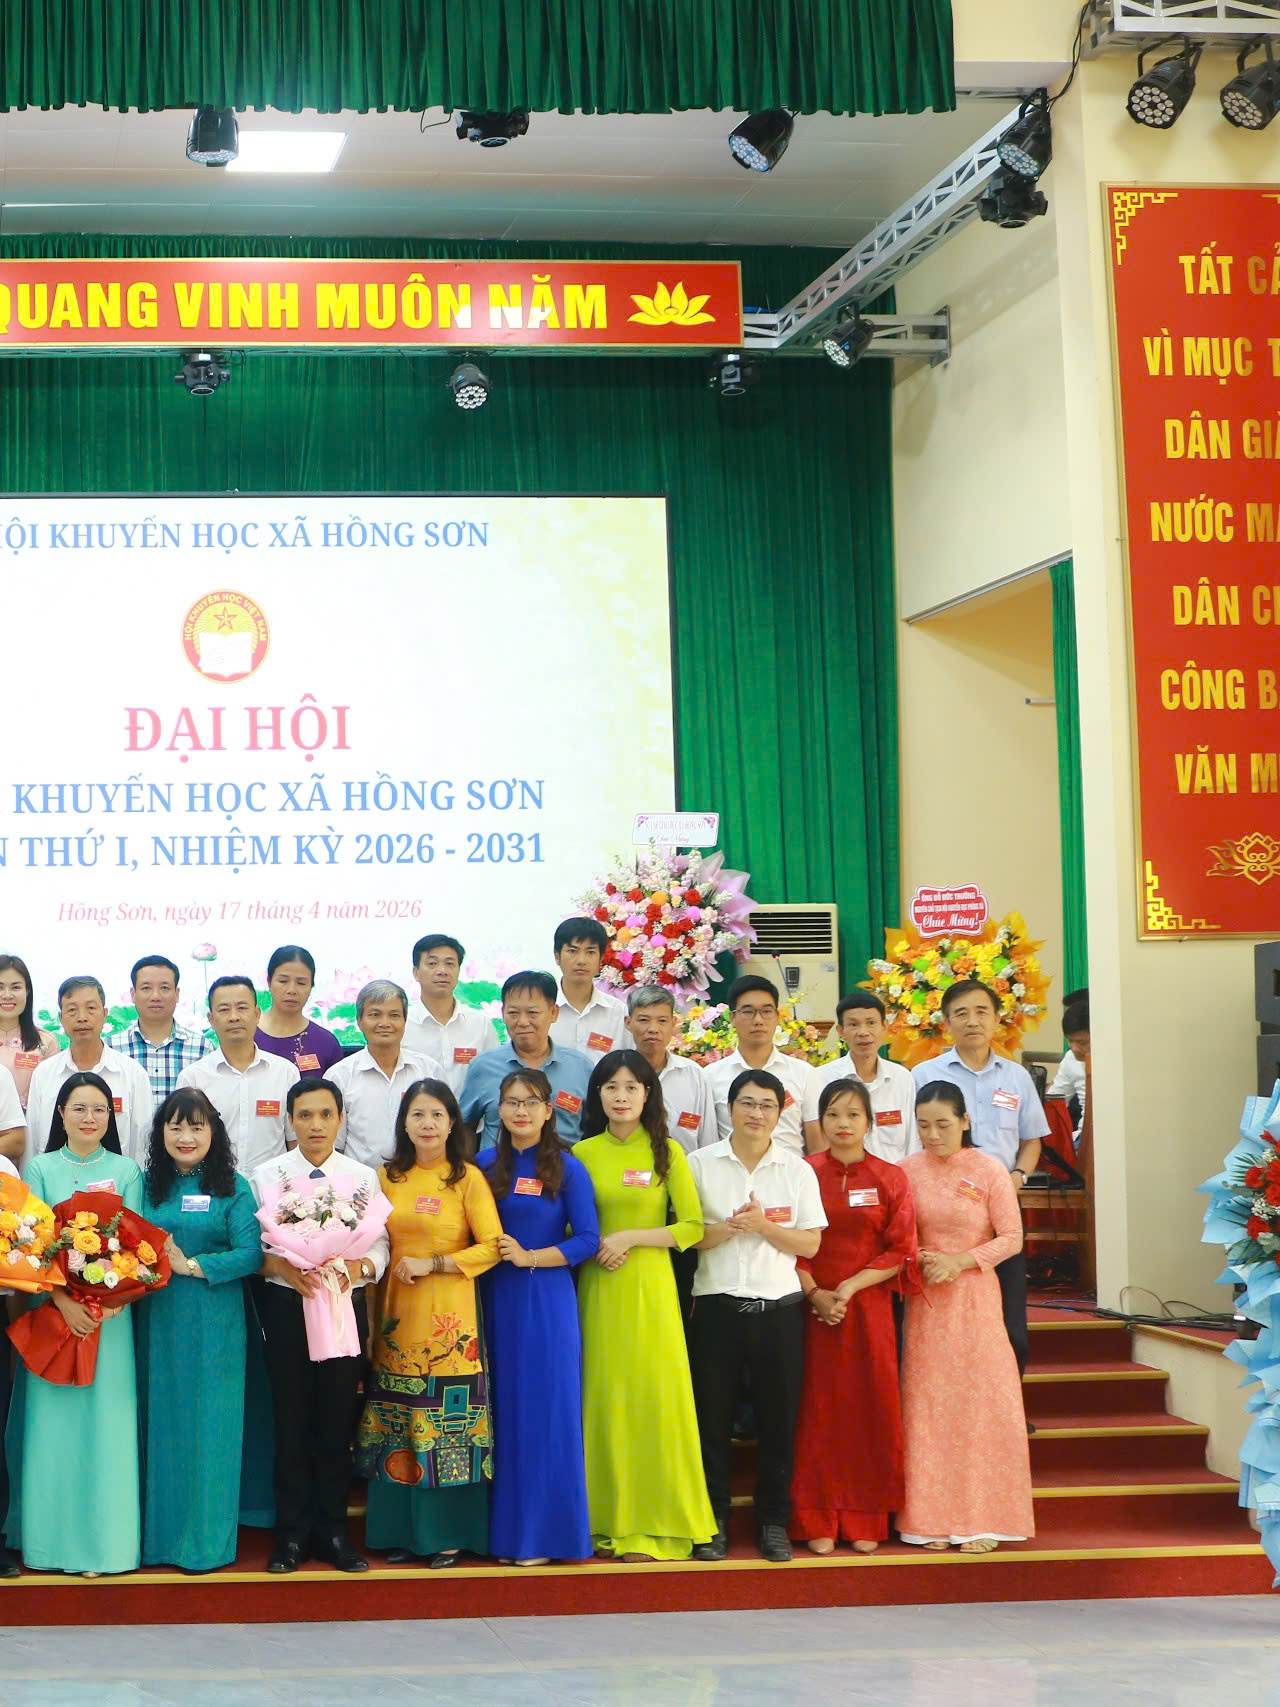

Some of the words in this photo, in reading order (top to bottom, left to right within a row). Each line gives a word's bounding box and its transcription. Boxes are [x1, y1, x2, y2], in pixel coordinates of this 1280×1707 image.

[1179, 241, 1233, 294] TẤT
[174, 282, 299, 329] VINH
[316, 272, 472, 329] MUÔN
[488, 273, 607, 329] NĂM
[1143, 328, 1173, 376] VÌ
[1183, 337, 1252, 385] MỤC
[1165, 410, 1231, 459] DÂN
[1242, 411, 1280, 459] GI
[50, 514, 181, 549] KHUYẾN
[192, 523, 258, 555] HỌC
[269, 515, 312, 547] XÃ
[322, 513, 414, 547] HỒNG
[424, 520, 488, 547] SƠN
[1150, 493, 1234, 542] NƯỚC
[1246, 503, 1280, 542] M
[1173, 577, 1240, 625] DÂN
[1161, 660, 1245, 710] CÔNG
[125, 706, 224, 764] ĐẠI
[245, 694, 351, 763] HỘI
[1175, 745, 1237, 794] VĂN
[13, 773, 173, 813] KHUYẾN
[186, 782, 266, 820] HỌC
[279, 773, 332, 811] XÃ
[343, 771, 455, 811] HỒNG
[467, 778, 545, 811] SƠN
[20, 826, 104, 866] THỨ
[116, 836, 138, 872] I,
[152, 826, 282, 874] NHIỆM
[294, 827, 344, 865] KỲ
[355, 833, 434, 864] 2026
[467, 832, 544, 863] 2031
[58, 899, 110, 926] Hồng
[116, 900, 158, 924] Sơn,
[164, 903, 212, 926] ngày
[219, 901, 241, 919] 17
[247, 899, 305, 924] tháng
[308, 901, 320, 918] 4
[327, 902, 371, 919] năm
[375, 900, 422, 918] 2026
